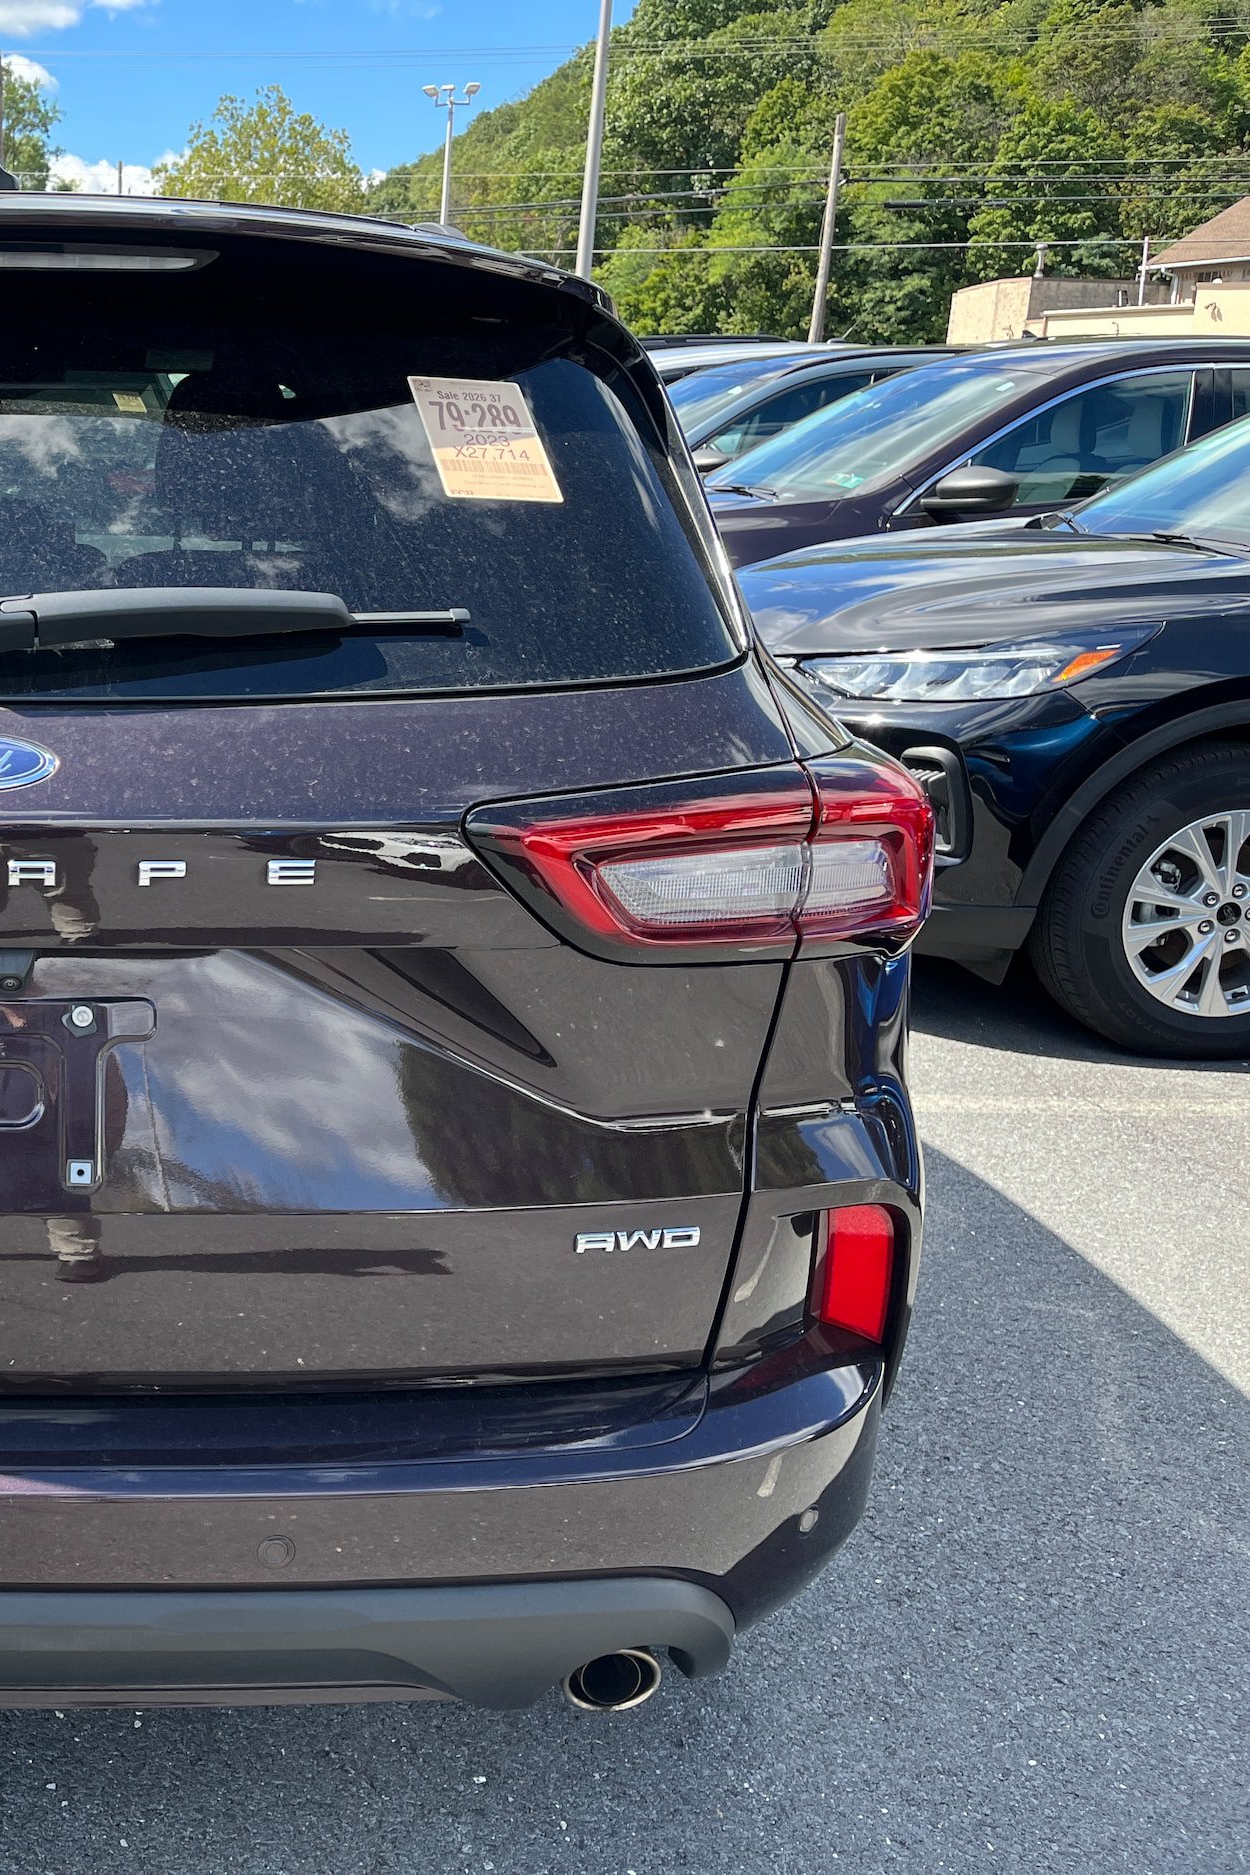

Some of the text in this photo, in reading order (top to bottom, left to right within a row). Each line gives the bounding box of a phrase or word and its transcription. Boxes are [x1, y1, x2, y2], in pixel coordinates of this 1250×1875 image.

[437, 390, 460, 401] Sale
[462, 391, 487, 402] 2026
[463, 433, 511, 447] 2023
[453, 446, 531, 462] X27,714
[576, 1226, 701, 1254] AWD
